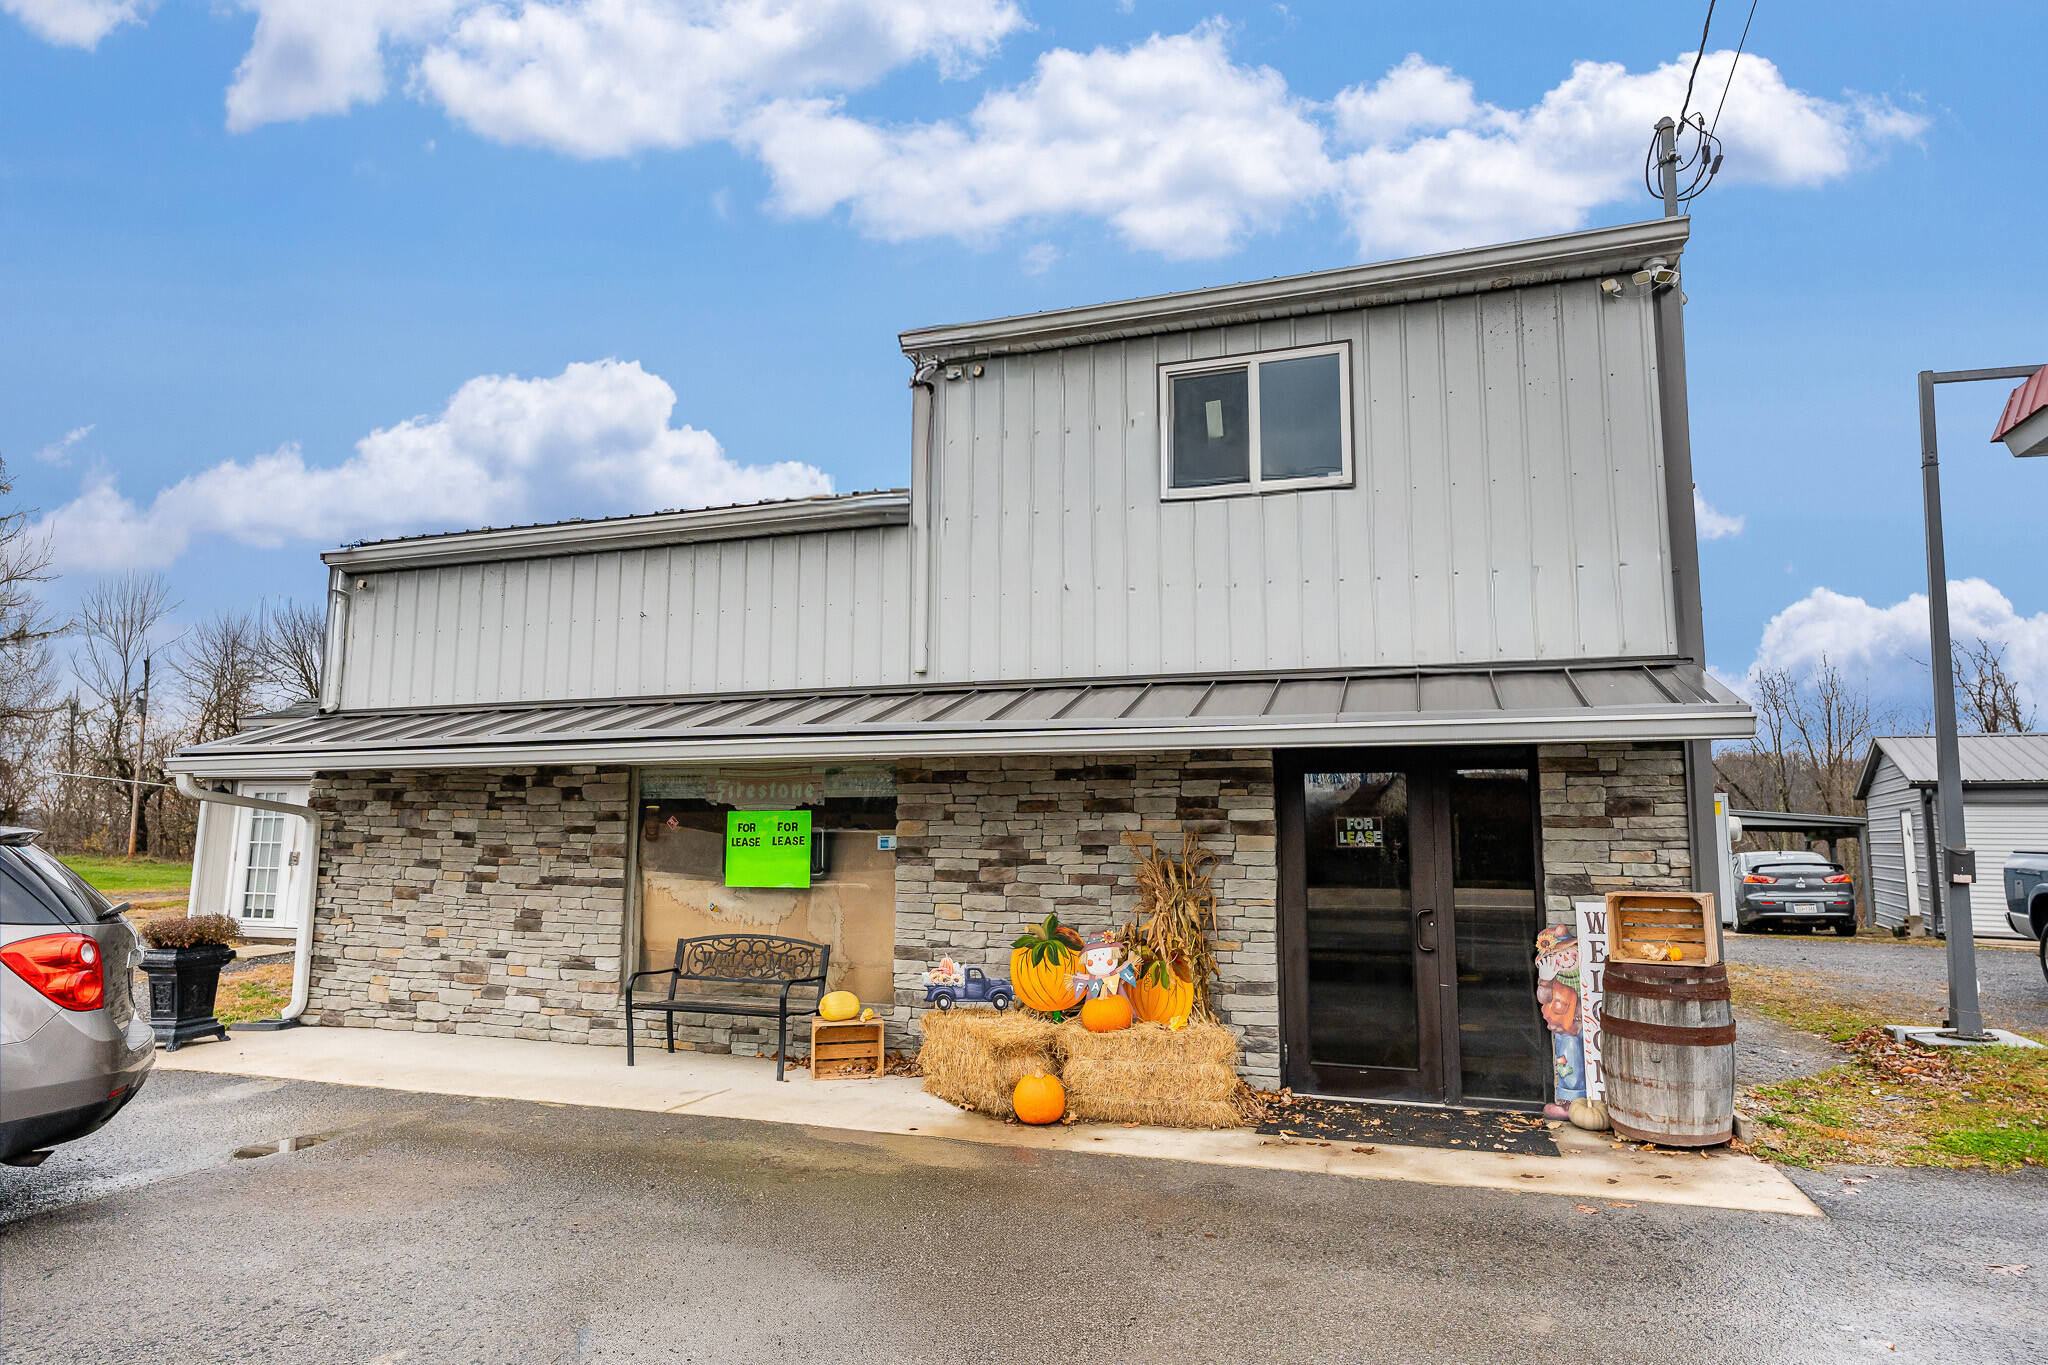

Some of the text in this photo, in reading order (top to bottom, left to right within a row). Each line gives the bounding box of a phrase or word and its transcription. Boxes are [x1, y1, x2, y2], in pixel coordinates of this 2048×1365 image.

[714, 780, 815, 800] Firestone
[737, 822, 756, 833] FOR
[777, 821, 799, 832] FOR
[1346, 818, 1374, 830] FOR
[731, 836, 761, 847] LEASE
[772, 835, 805, 846] LEASE
[1339, 831, 1382, 843] LEASE
[1075, 972, 1134, 992] FALL
[1581, 982, 1598, 1066] everyone
